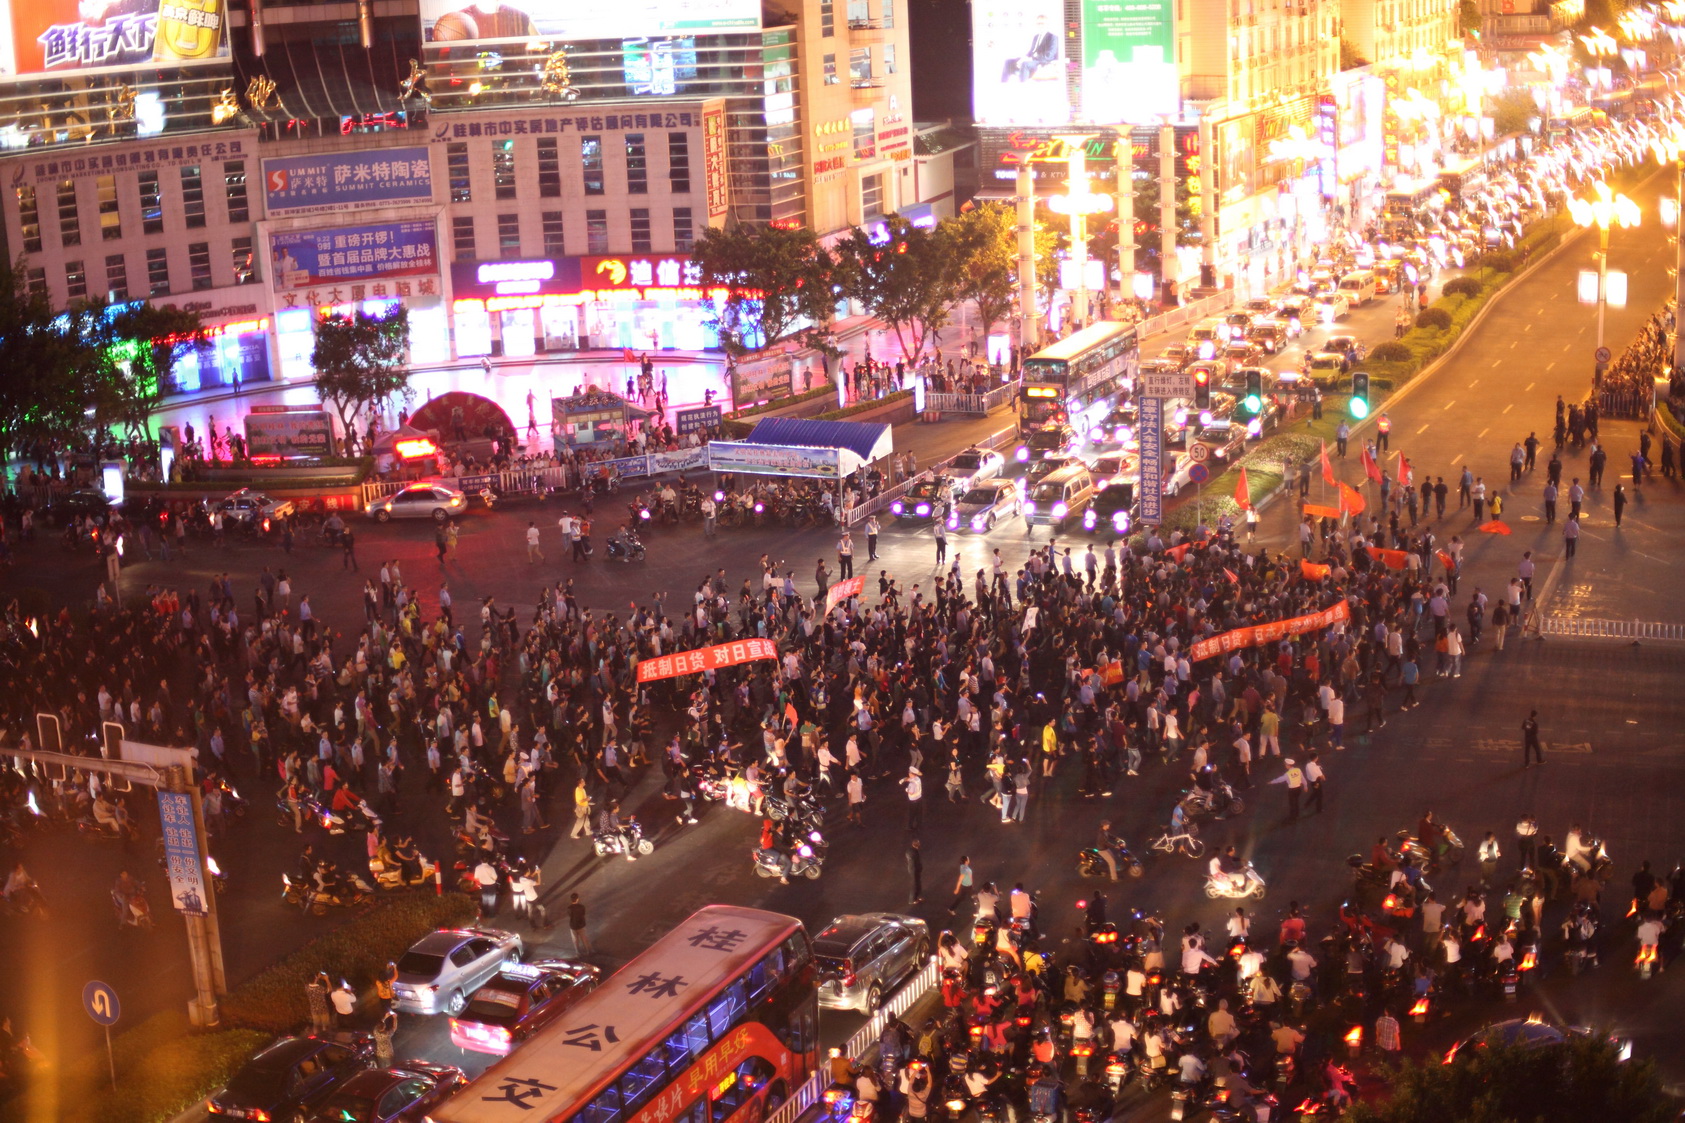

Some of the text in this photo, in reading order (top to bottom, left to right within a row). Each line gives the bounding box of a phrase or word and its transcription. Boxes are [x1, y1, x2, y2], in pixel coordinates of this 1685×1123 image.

[291, 176, 328, 190] 萨米特
[333, 159, 430, 184] 萨米特陶瓷
[335, 179, 431, 192] SUMMIT CERAMICS
[318, 243, 431, 267] 暨首届品牌大惠战
[282, 279, 436, 308] 文化大厦电脑城
[1194, 447, 1205, 459] 50
[643, 640, 777, 680] 抵制日货 对日宣战
[161, 793, 185, 884] 人让车 让出一份安全
[174, 795, 199, 886] 车让人 让出一份文明
[482, 926, 748, 1110] 桂林公交
[687, 1027, 750, 1091] 早用早好
